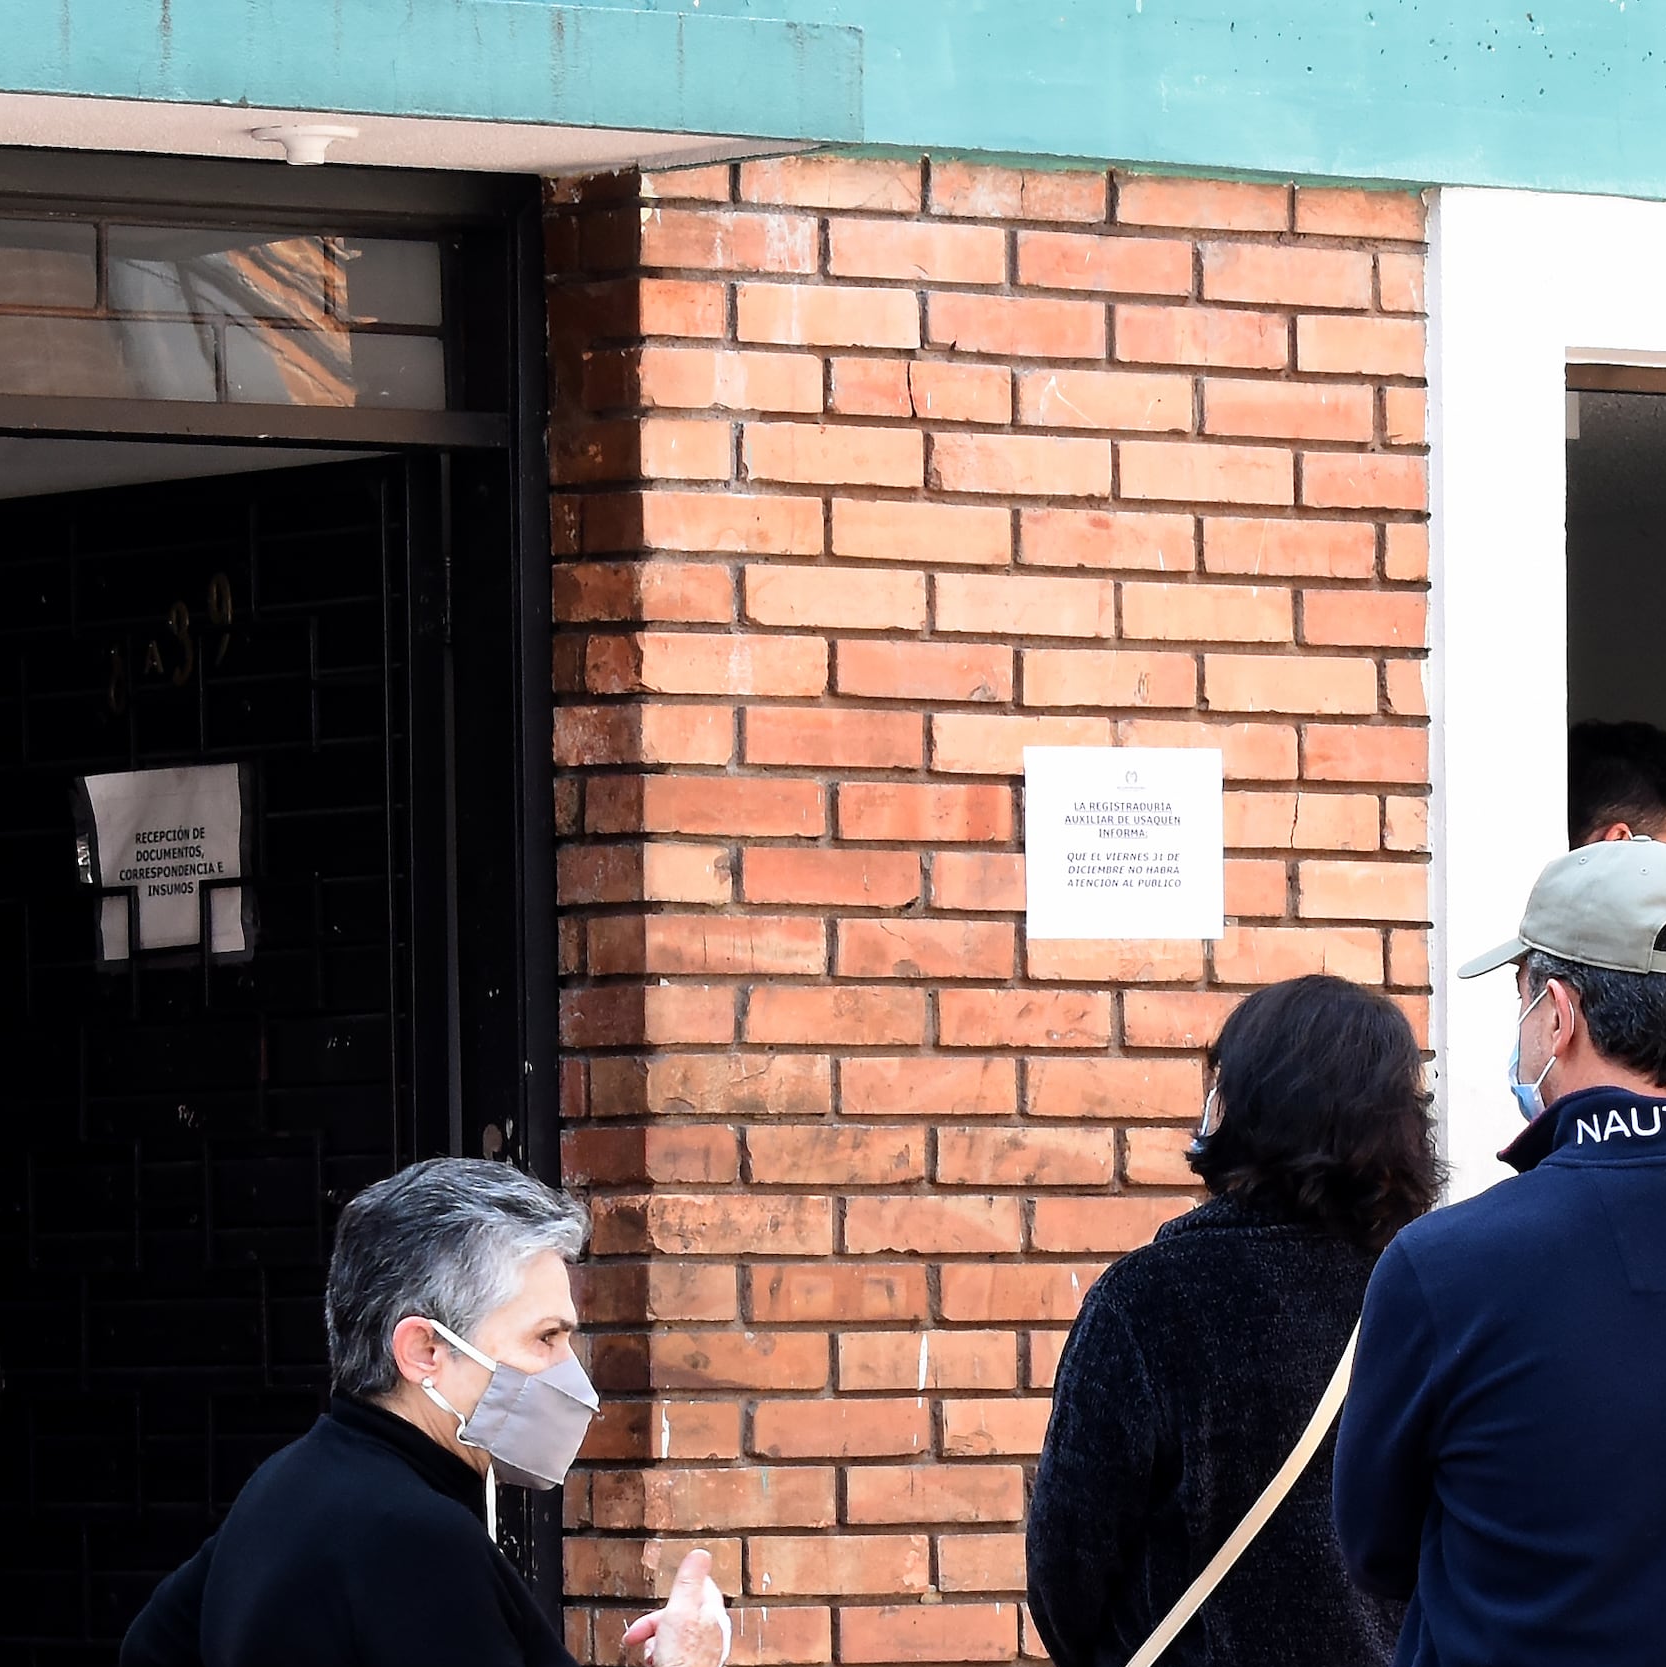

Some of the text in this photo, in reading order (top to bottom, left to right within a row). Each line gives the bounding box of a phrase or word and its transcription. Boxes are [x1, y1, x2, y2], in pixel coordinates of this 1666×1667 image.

[1074, 802, 1086, 812] LA
[1065, 815, 1114, 825] AUXILIAR
[1118, 815, 1131, 825] DE
[135, 825, 205, 844] RECEPCIÓN DE
[136, 846, 205, 862] DOCUMENTOS,
[1067, 852, 1088, 862] QUE
[1091, 852, 1102, 861] EL
[1106, 852, 1149, 861] VIERNES
[1167, 852, 1180, 861] DE
[119, 862, 224, 881] CORRESPONDENCIA E
[1068, 865, 1125, 875] DICIEMBRE
[1128, 865, 1143, 875] NO
[1122, 879, 1135, 888] AL
[148, 882, 194, 897] INSUMOS
